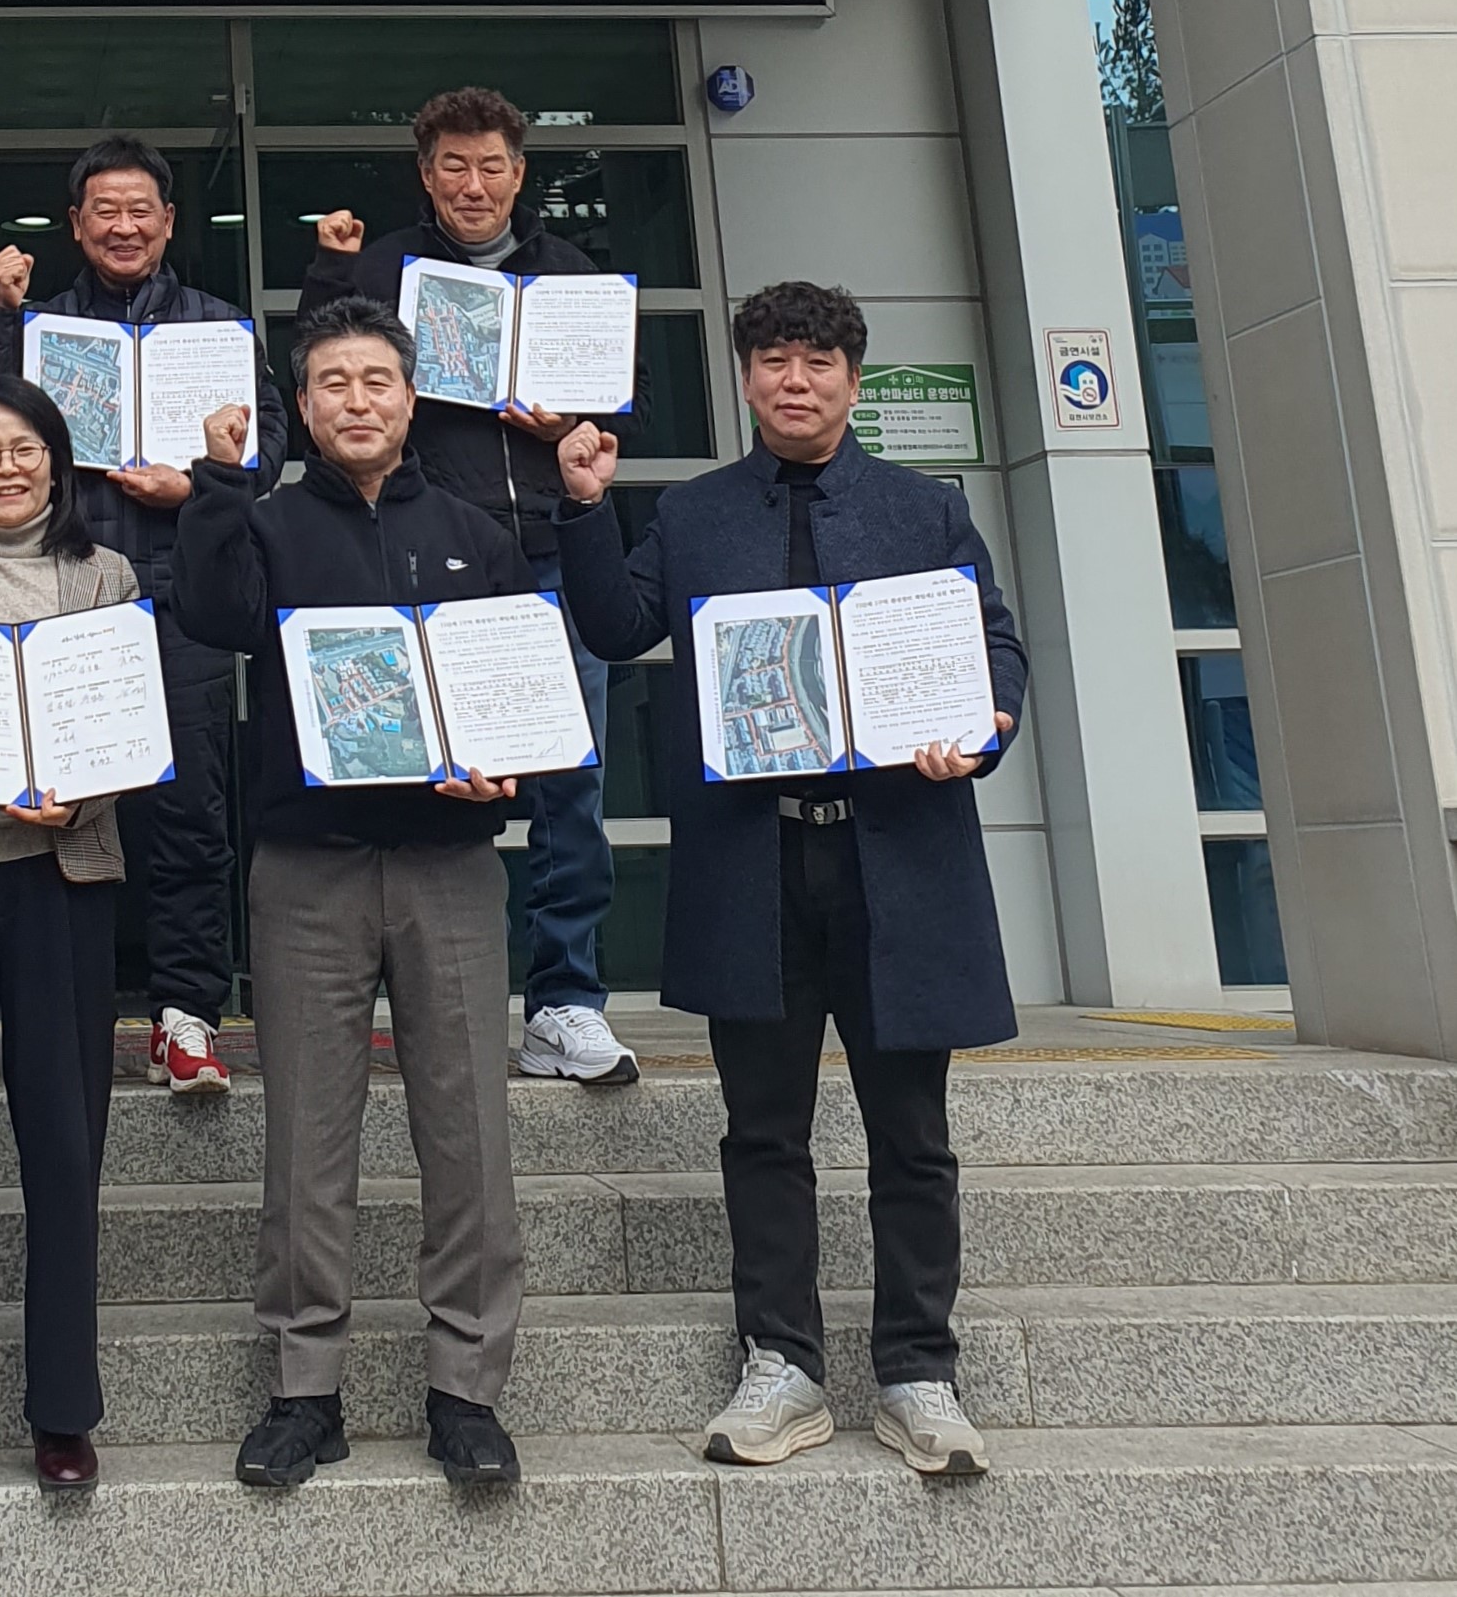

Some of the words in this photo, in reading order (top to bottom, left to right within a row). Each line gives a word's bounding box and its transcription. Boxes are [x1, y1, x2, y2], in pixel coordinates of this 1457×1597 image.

[1058, 346, 1100, 357] 금연시설
[927, 387, 971, 401] 운영안내
[1068, 413, 1109, 422] 김천시보건소
